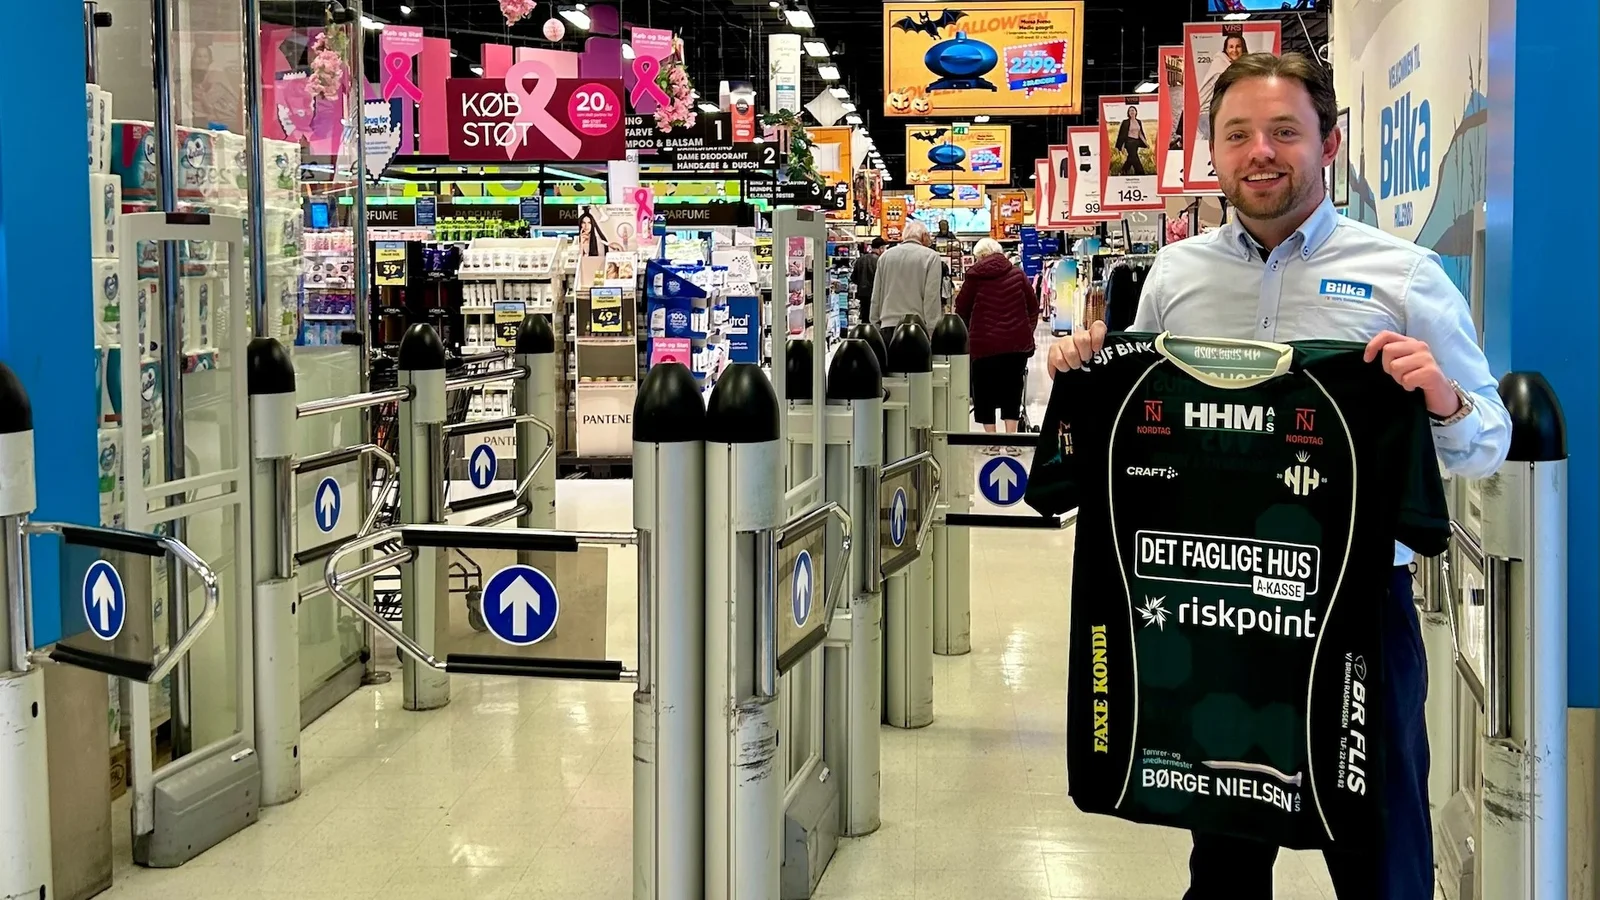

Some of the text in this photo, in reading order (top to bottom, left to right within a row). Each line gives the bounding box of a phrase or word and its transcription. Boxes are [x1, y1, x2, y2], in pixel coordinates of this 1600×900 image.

[1009, 57, 1061, 73] 2299.-
[462, 92, 522, 117] KØB
[576, 91, 605, 111] 20
[625, 117, 642, 125] ING
[463, 122, 533, 146] STØT
[625, 128, 653, 136] FARVE
[714, 120, 722, 140] 1
[656, 139, 663, 147] &
[666, 138, 703, 147] BALSAM
[1381, 91, 1430, 200] Bilka
[700, 152, 748, 160] DEODORANT
[764, 147, 775, 164] 2
[677, 161, 719, 169] HÅNDSÆBE
[732, 161, 759, 169] DUSCH
[811, 183, 820, 195] 3
[824, 189, 832, 200] 4
[1118, 189, 1147, 202] 149.-
[836, 197, 844, 207] 5
[664, 209, 710, 219] PARFUME
[383, 264, 397, 274] 39
[1325, 281, 1366, 297] Bilka
[598, 311, 613, 321] 49
[503, 325, 517, 336] 25
[1093, 341, 1155, 365] SJF BANK
[583, 414, 631, 424] PANTENE
[1185, 402, 1263, 431] HHM
[1137, 426, 1171, 435] NORDTAG
[1285, 434, 1323, 445] NORDTAG
[1126, 466, 1166, 478] CRAFT
[1284, 464, 1320, 496] NH
[1142, 537, 1311, 579] DET FAGLIGE HUS
[1257, 579, 1302, 598] A-KASSE
[1178, 596, 1316, 638] riskpoint
[1344, 662, 1352, 684] BRIAN
[1091, 624, 1108, 754] FAXE KONDI
[1341, 684, 1350, 728] RASMUSSEN
[1347, 680, 1366, 796] BR FLIS
[1142, 748, 1181, 760] Tømrer- og
[1142, 757, 1193, 769] snedkermester
[1142, 768, 1210, 795] BØRGE
[1216, 777, 1292, 812] NIELSEN
